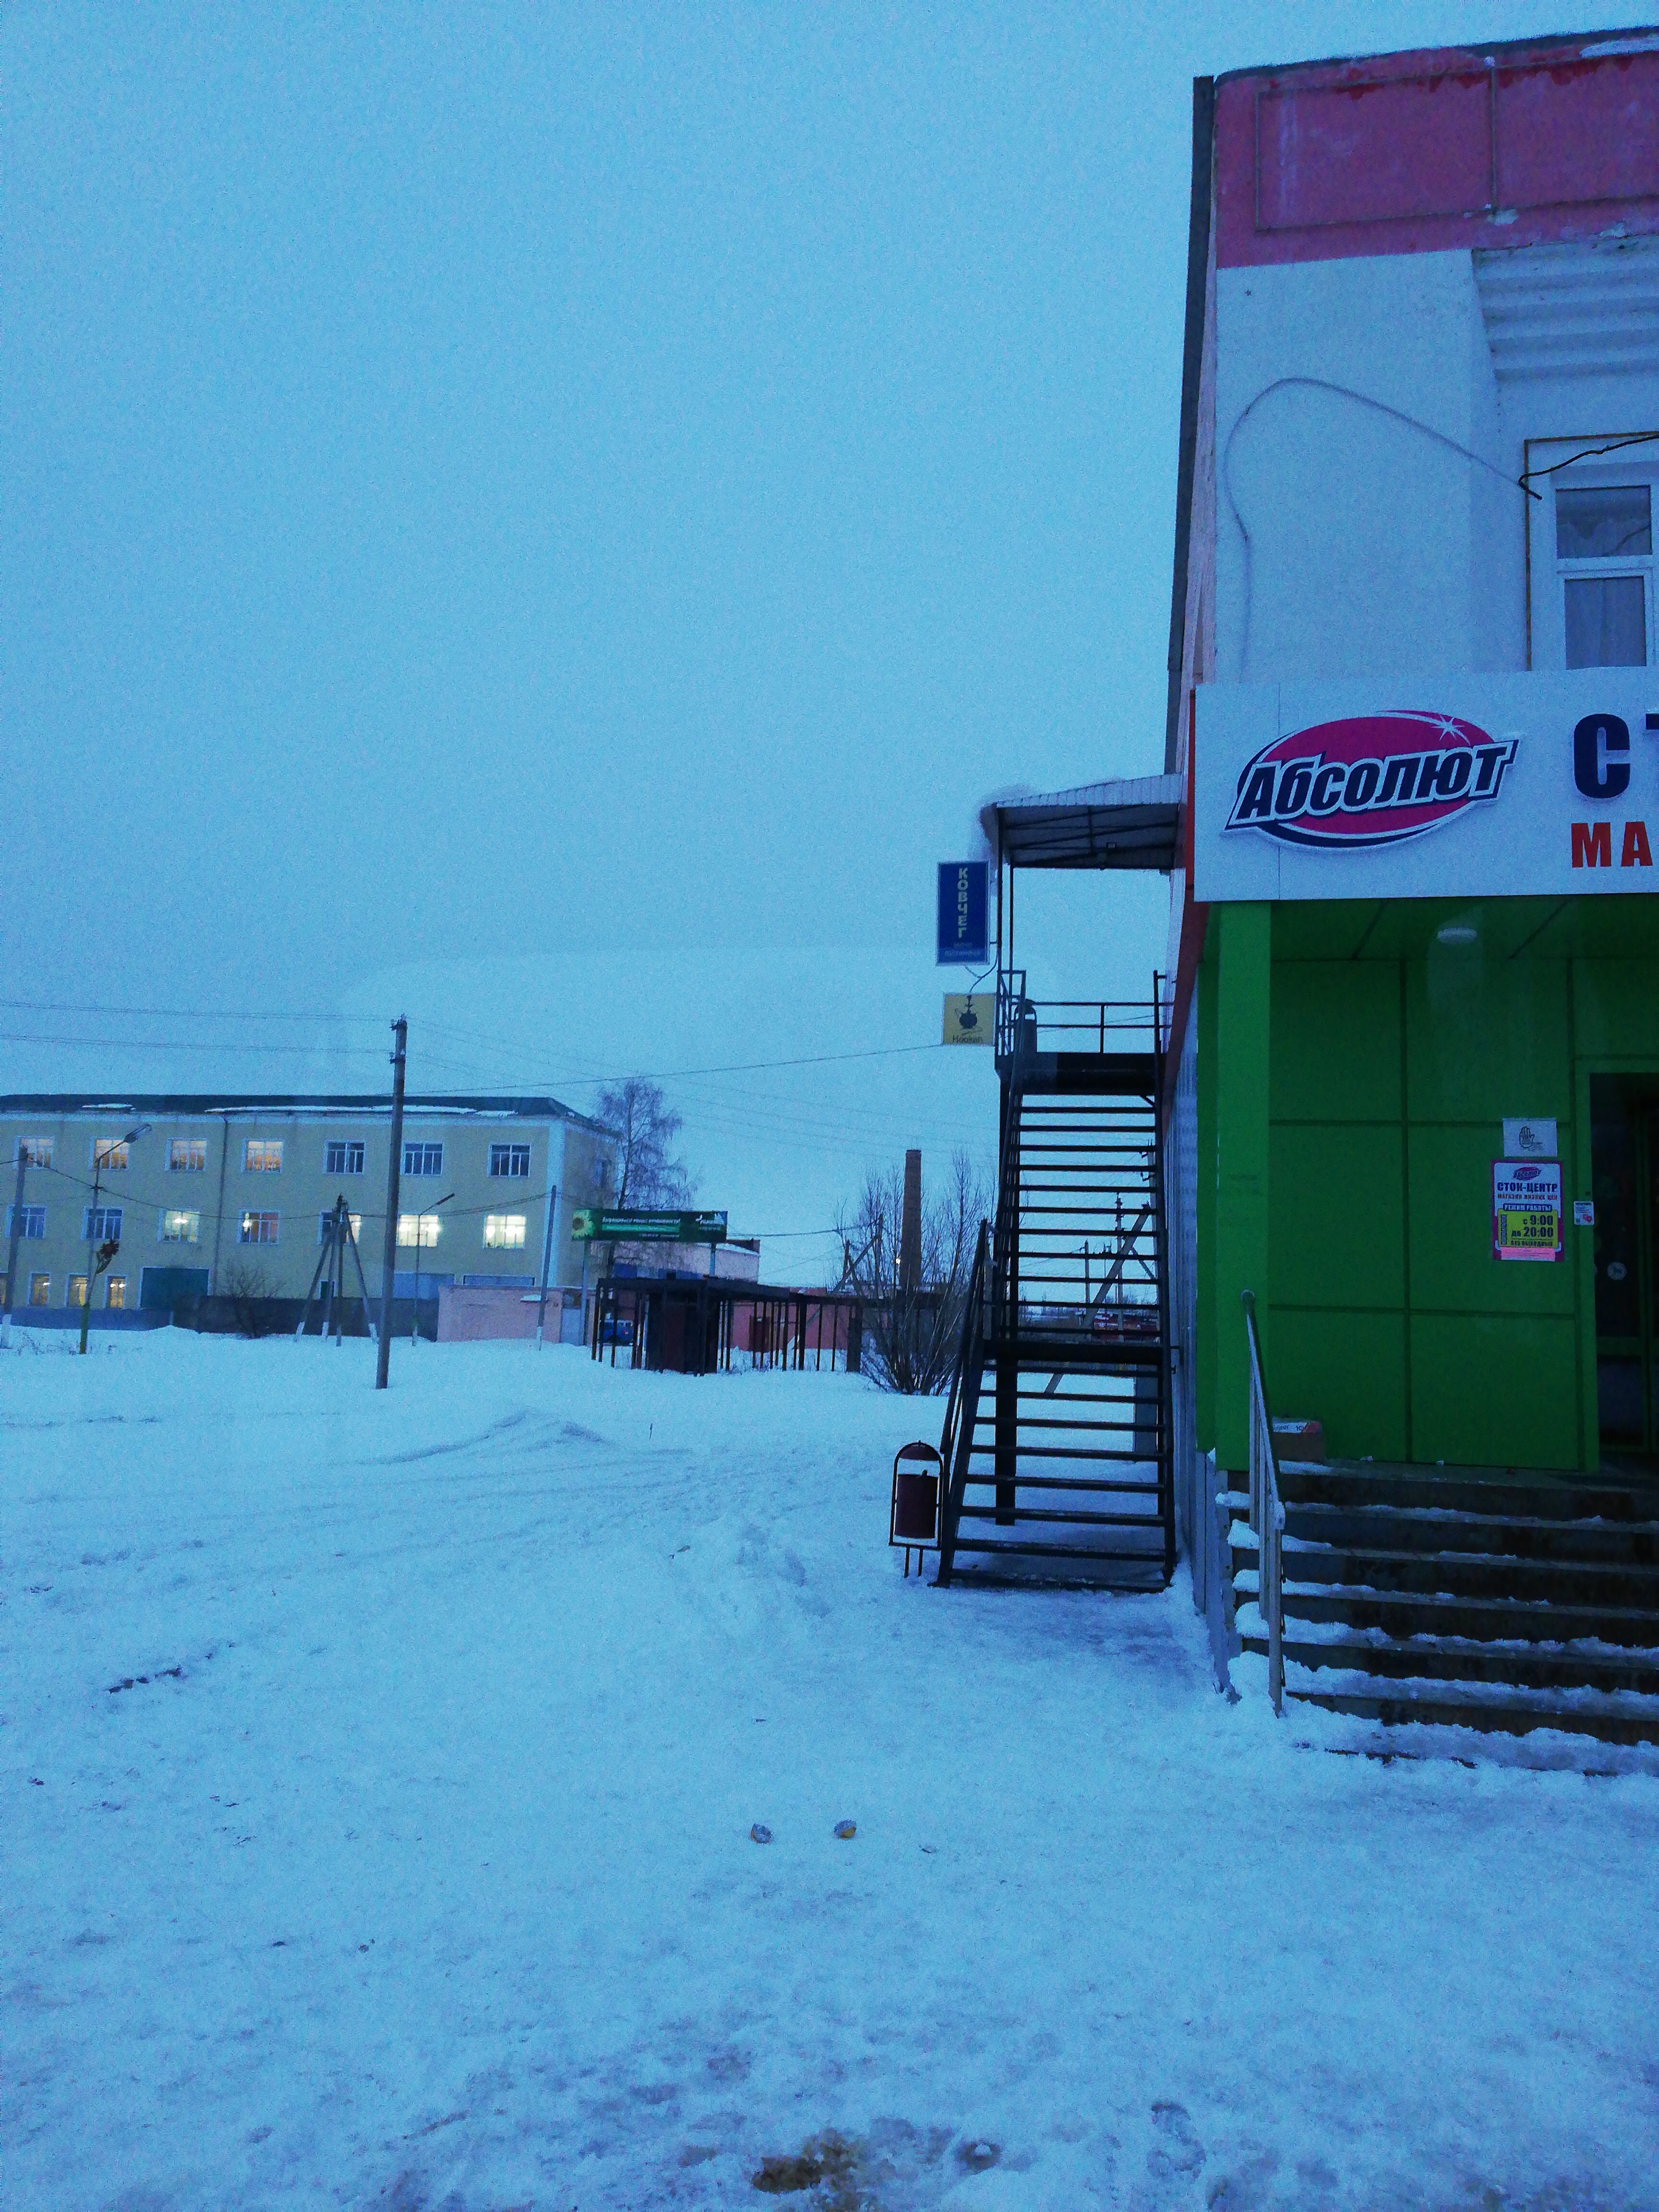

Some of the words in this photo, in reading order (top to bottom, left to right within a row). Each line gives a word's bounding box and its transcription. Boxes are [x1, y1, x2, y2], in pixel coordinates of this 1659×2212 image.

[1236, 744, 1512, 820] Абсолют
[957, 867, 969, 939] КОВЧЕГ
[1497, 1182, 1558, 1193] СТОК-ЦЕНТР
[1530, 1215, 1553, 1225] 9:00
[1523, 1227, 1554, 1238] 20:00
